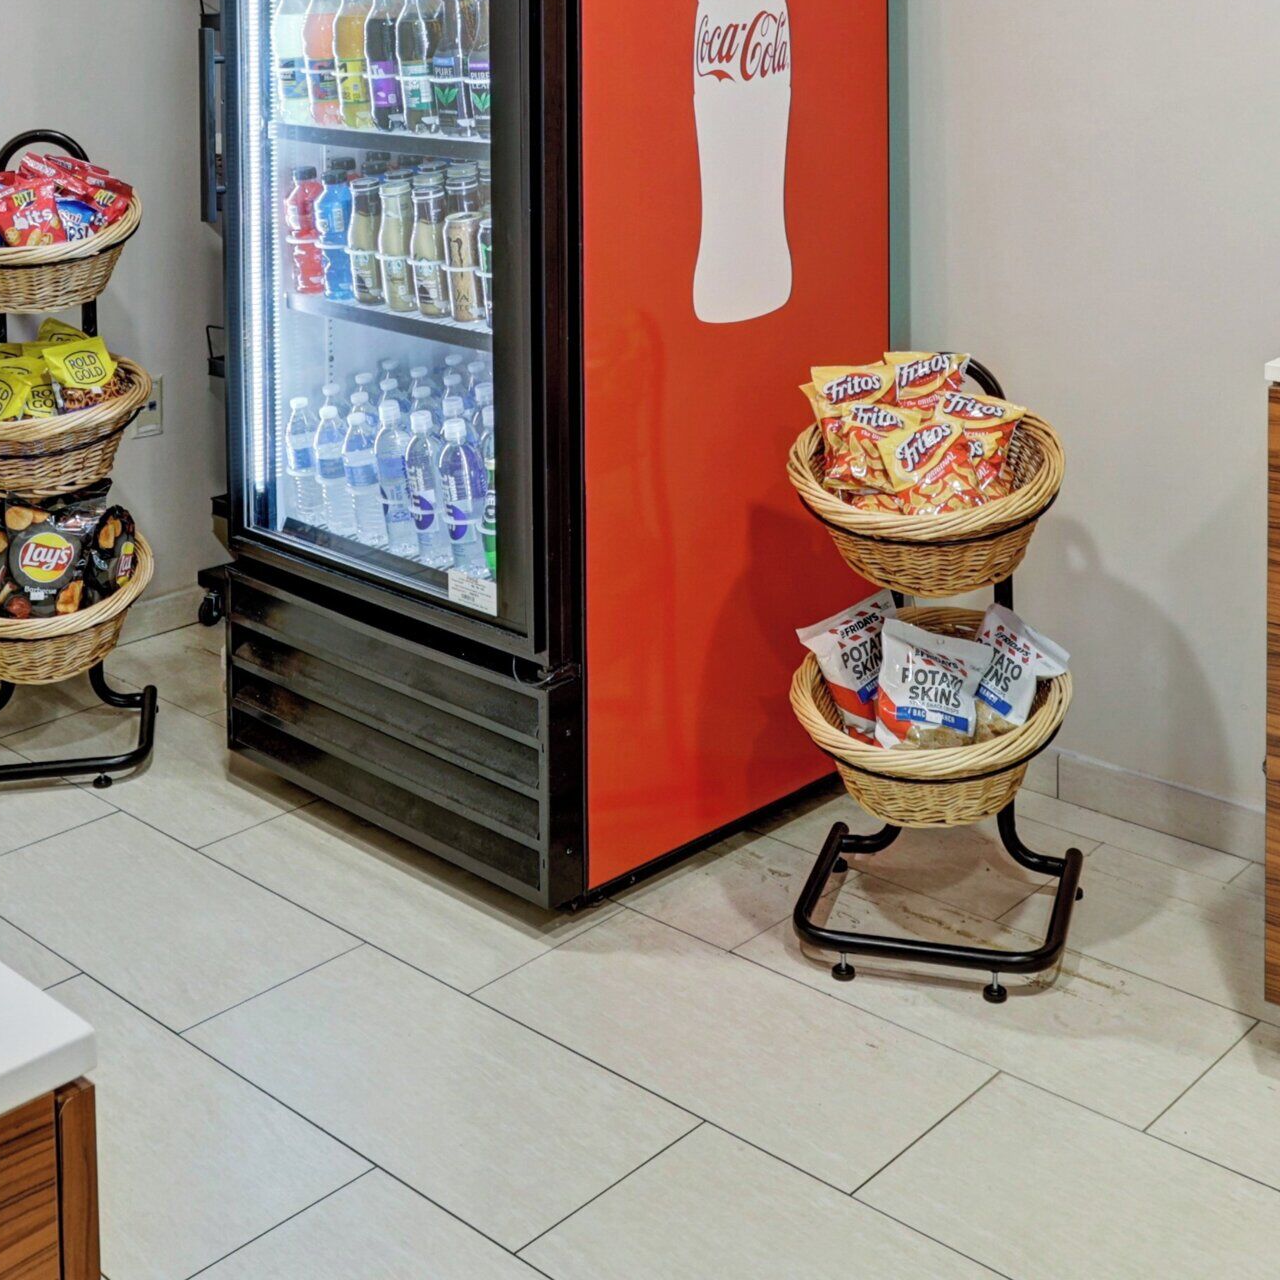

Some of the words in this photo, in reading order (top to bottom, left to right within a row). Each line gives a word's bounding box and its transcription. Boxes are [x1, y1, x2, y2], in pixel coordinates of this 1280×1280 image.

[697, 10, 790, 83] Coca-Cola
[12, 189, 38, 208] RITZ
[94, 188, 118, 207] RITZ
[68, 355, 97, 370] ROLD
[74, 367, 104, 381] GOLD
[32, 390, 54, 399] RO
[823, 375, 882, 405] Fritos
[31, 399, 55, 409] GO
[895, 423, 952, 473] Fritos
[22, 543, 71, 571] Lay's
[844, 612, 880, 638] FRIDAYS
[901, 666, 964, 693] POTATO
[908, 685, 963, 709] SKINS
